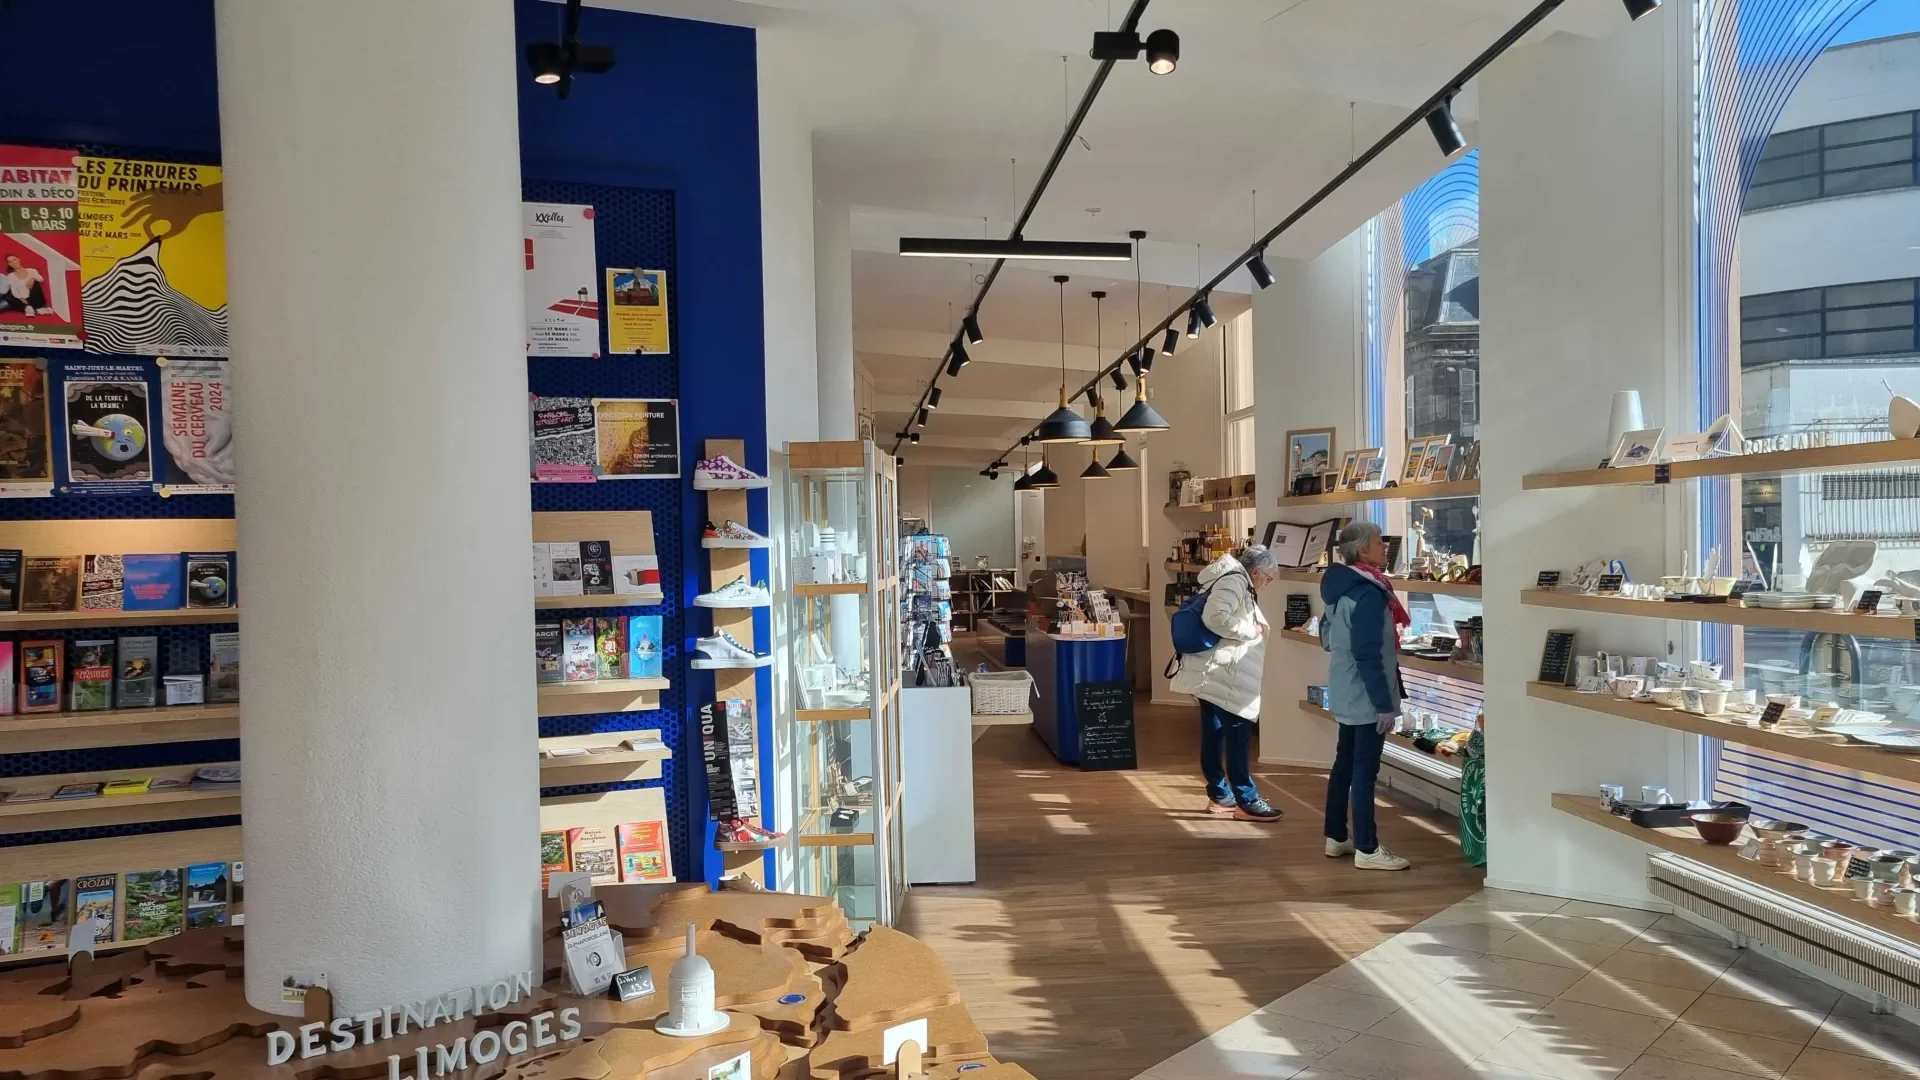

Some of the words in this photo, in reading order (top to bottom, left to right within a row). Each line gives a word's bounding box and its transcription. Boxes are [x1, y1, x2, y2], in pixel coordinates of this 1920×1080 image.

[112, 160, 198, 181] ZÉBRURES
[28, 189, 36, 199] &
[41, 186, 75, 199] DÉCO
[77, 175, 101, 189] DU
[107, 177, 203, 196] PRINTEMPS
[31, 220, 67, 231] MARS
[105, 231, 129, 240] MARS
[209, 381, 222, 411] 2024
[171, 381, 188, 437] SEMAINE
[189, 382, 206, 437] CERVEAU
[191, 440, 207, 459] DU
[77, 877, 115, 888] CROZANT
[564, 917, 608, 941] LIMOGES
[266, 970, 533, 1066] DESTINATION
[387, 1006, 582, 1080] LIMOGES
